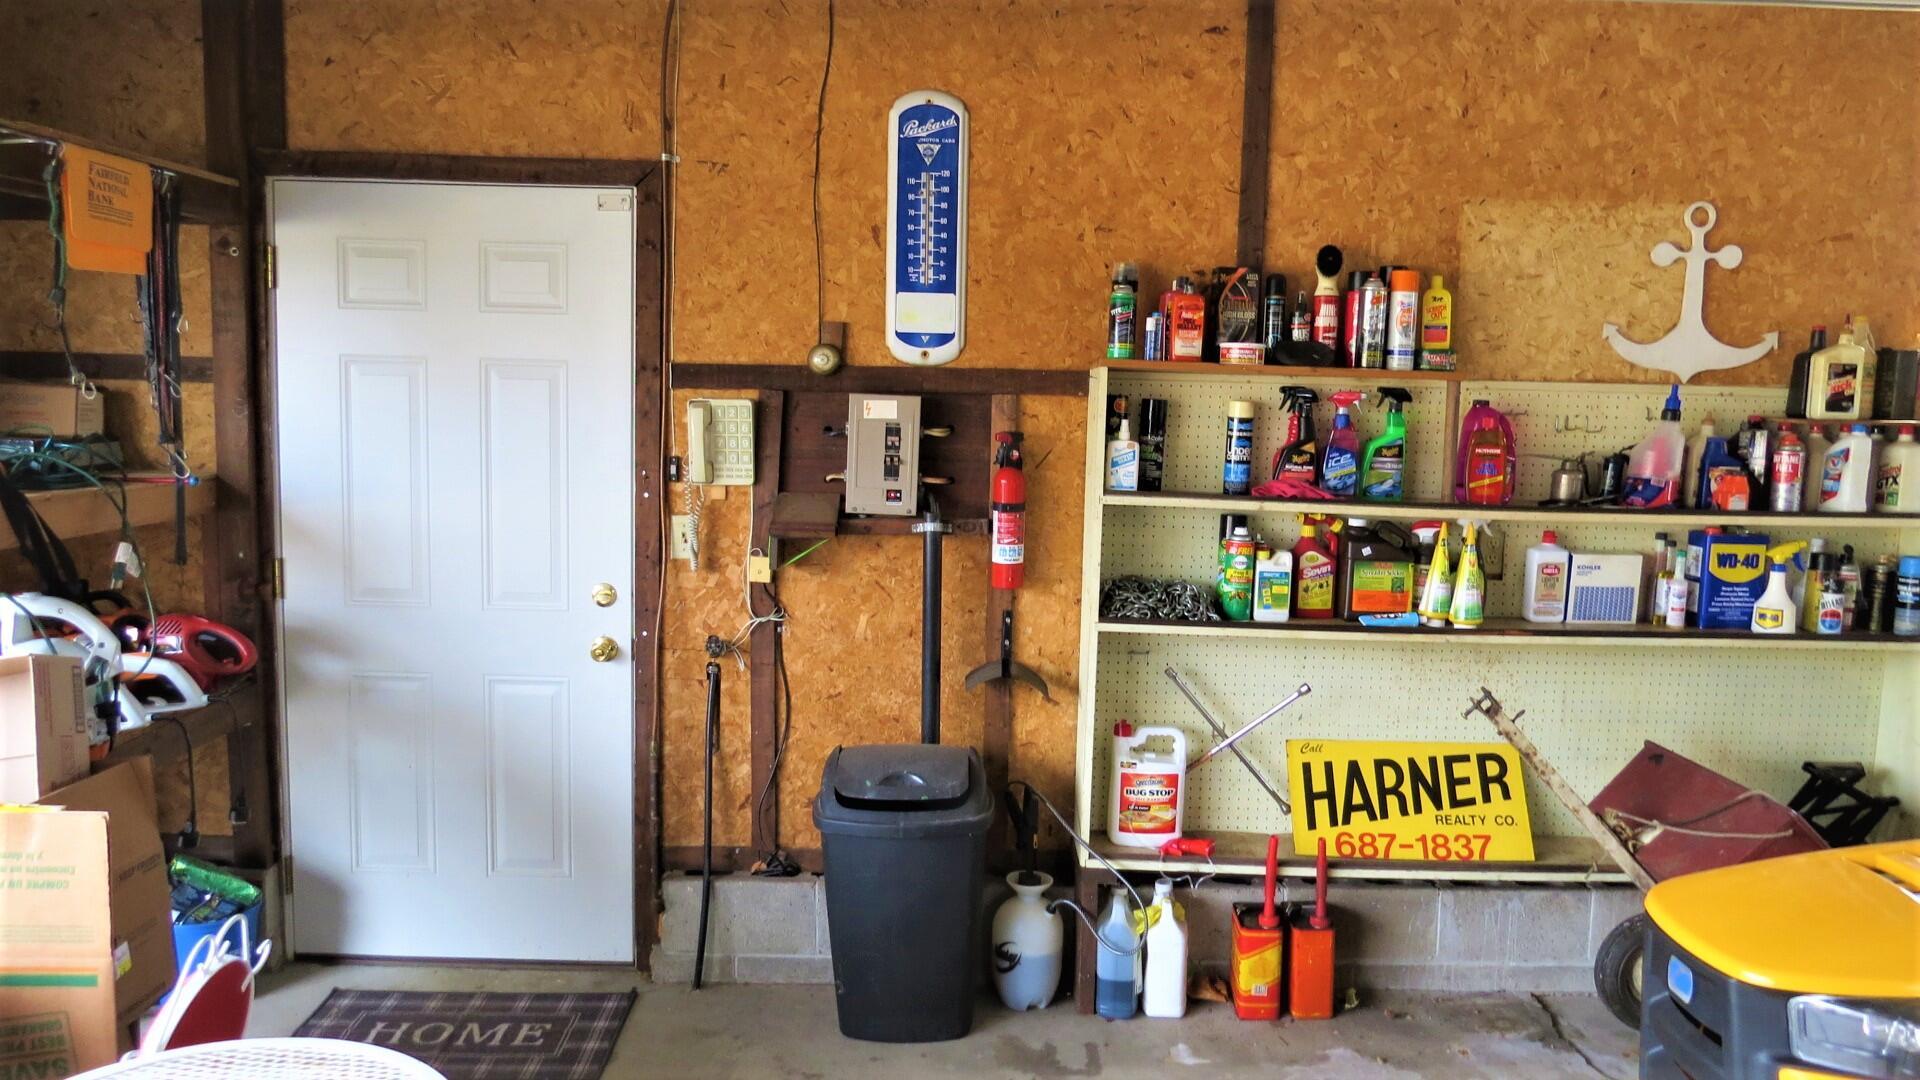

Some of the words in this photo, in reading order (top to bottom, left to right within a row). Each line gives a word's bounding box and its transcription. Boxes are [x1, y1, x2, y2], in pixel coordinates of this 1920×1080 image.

[900, 114, 958, 138] Packard
[1876, 474, 1900, 489] GTX
[1716, 553, 1760, 569] WD-40
[1303, 564, 1331, 578] Sevin
[1300, 742, 1324, 754] Call
[1125, 788, 1147, 796] BUG
[1148, 788, 1174, 796] STOP
[1301, 752, 1512, 831] HARNER
[1435, 814, 1487, 826] REALTY
[1494, 815, 1519, 827] CO.
[1335, 831, 1493, 861] 687-1837
[364, 1021, 553, 1047] HOME
